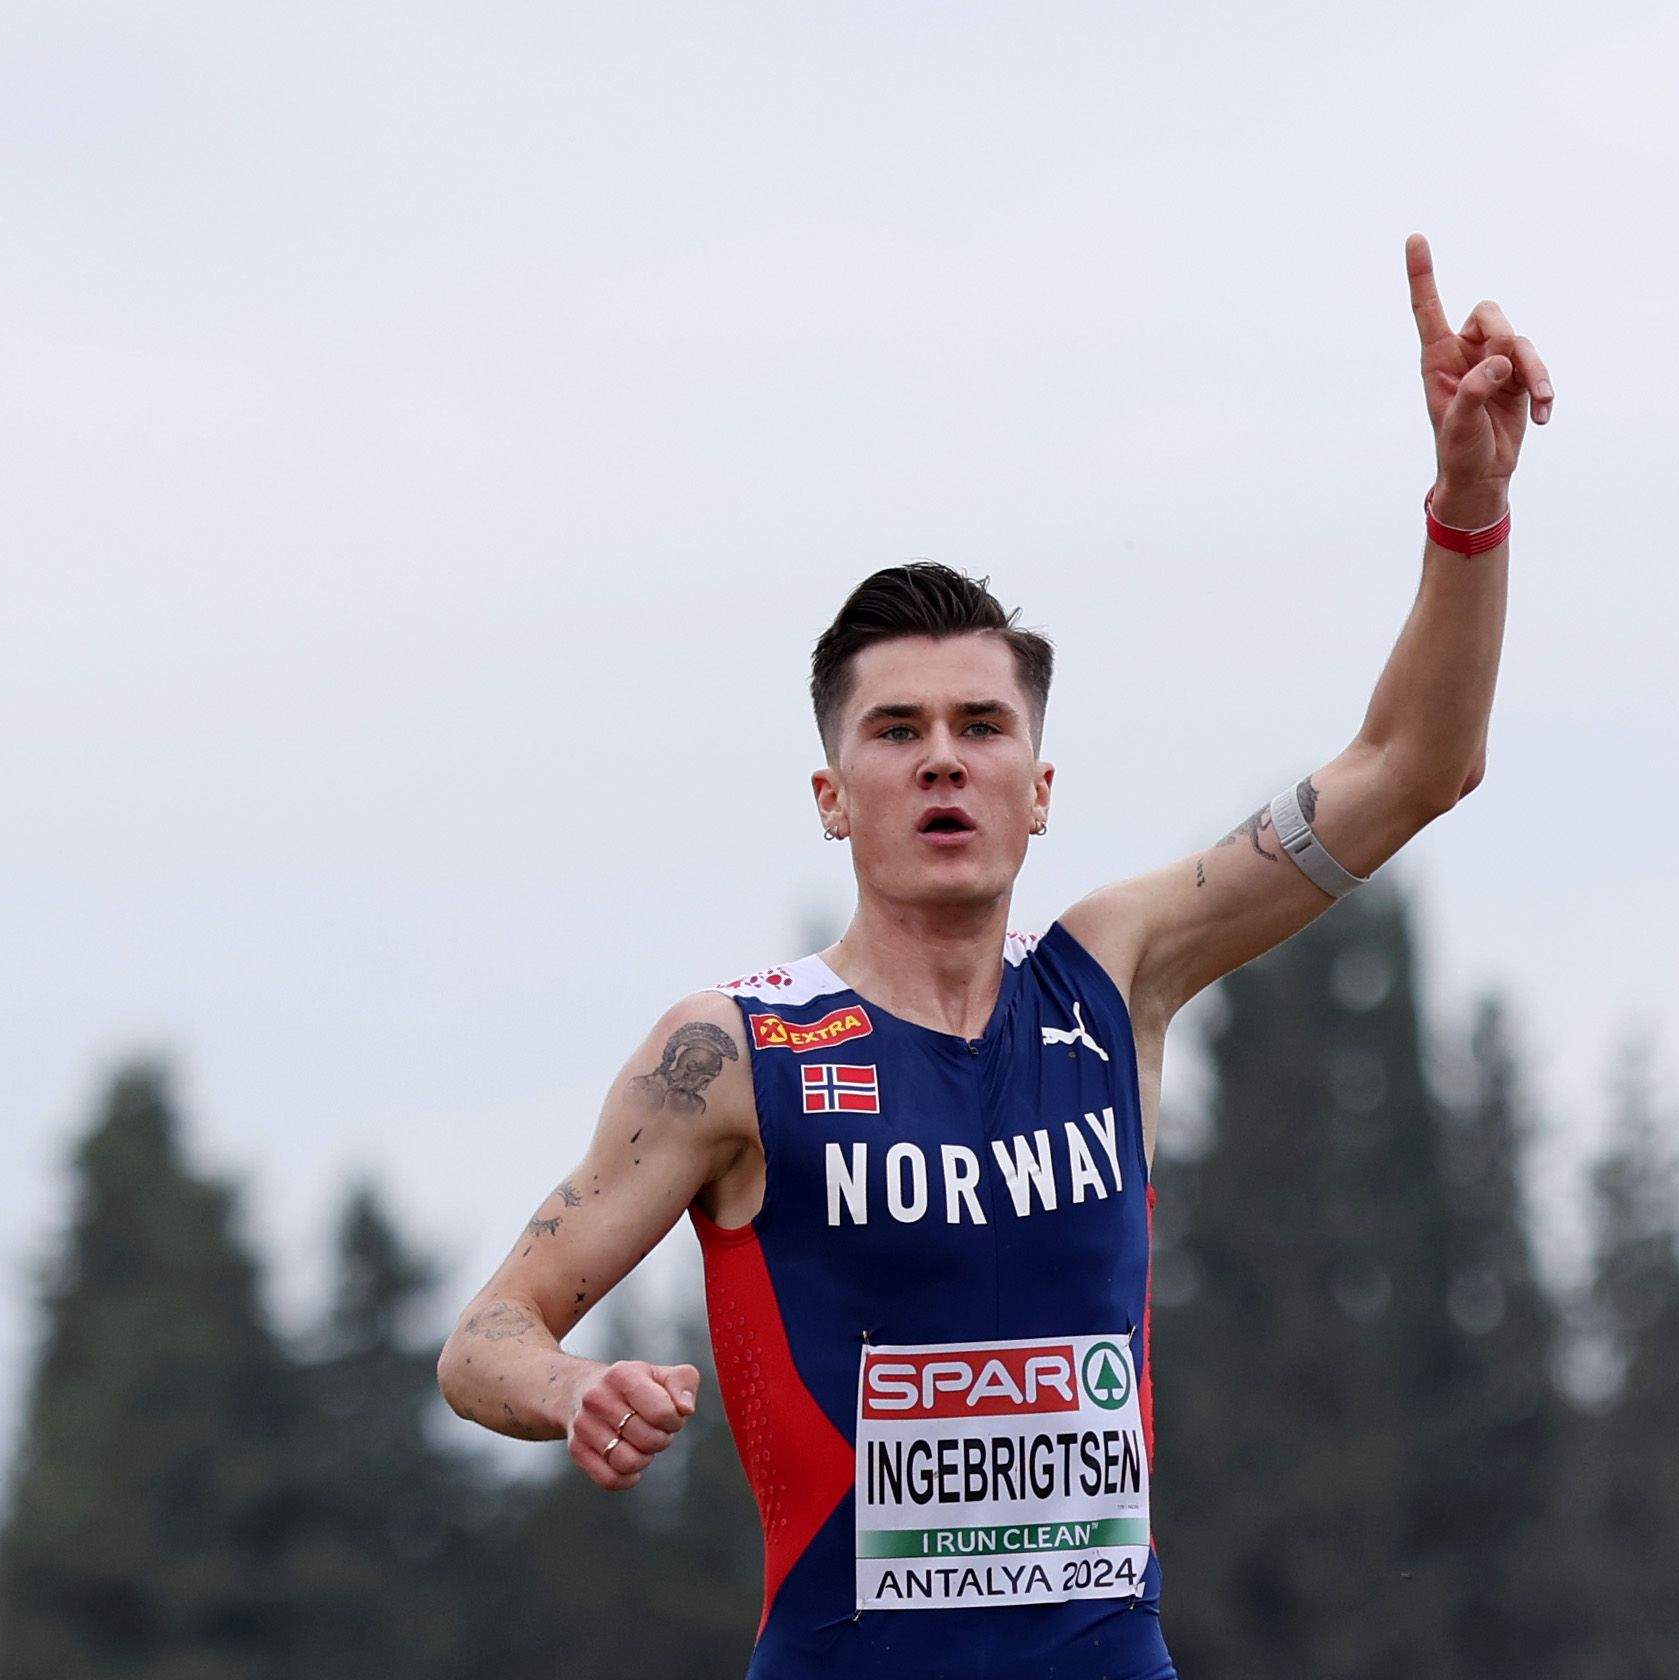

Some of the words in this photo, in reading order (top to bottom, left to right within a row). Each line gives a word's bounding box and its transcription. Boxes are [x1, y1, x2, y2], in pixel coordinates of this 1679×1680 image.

[790, 1015, 861, 1045] EXTRA
[826, 1107, 1122, 1226] NORWAY
[869, 1355, 1073, 1409] SPAR
[868, 1429, 1140, 1505] INGEBRIGTSEN
[923, 1532, 928, 1553] I
[937, 1529, 996, 1552] RUN
[876, 1564, 1052, 1599] ANTALYA
[1062, 1557, 1137, 1591] 2024
